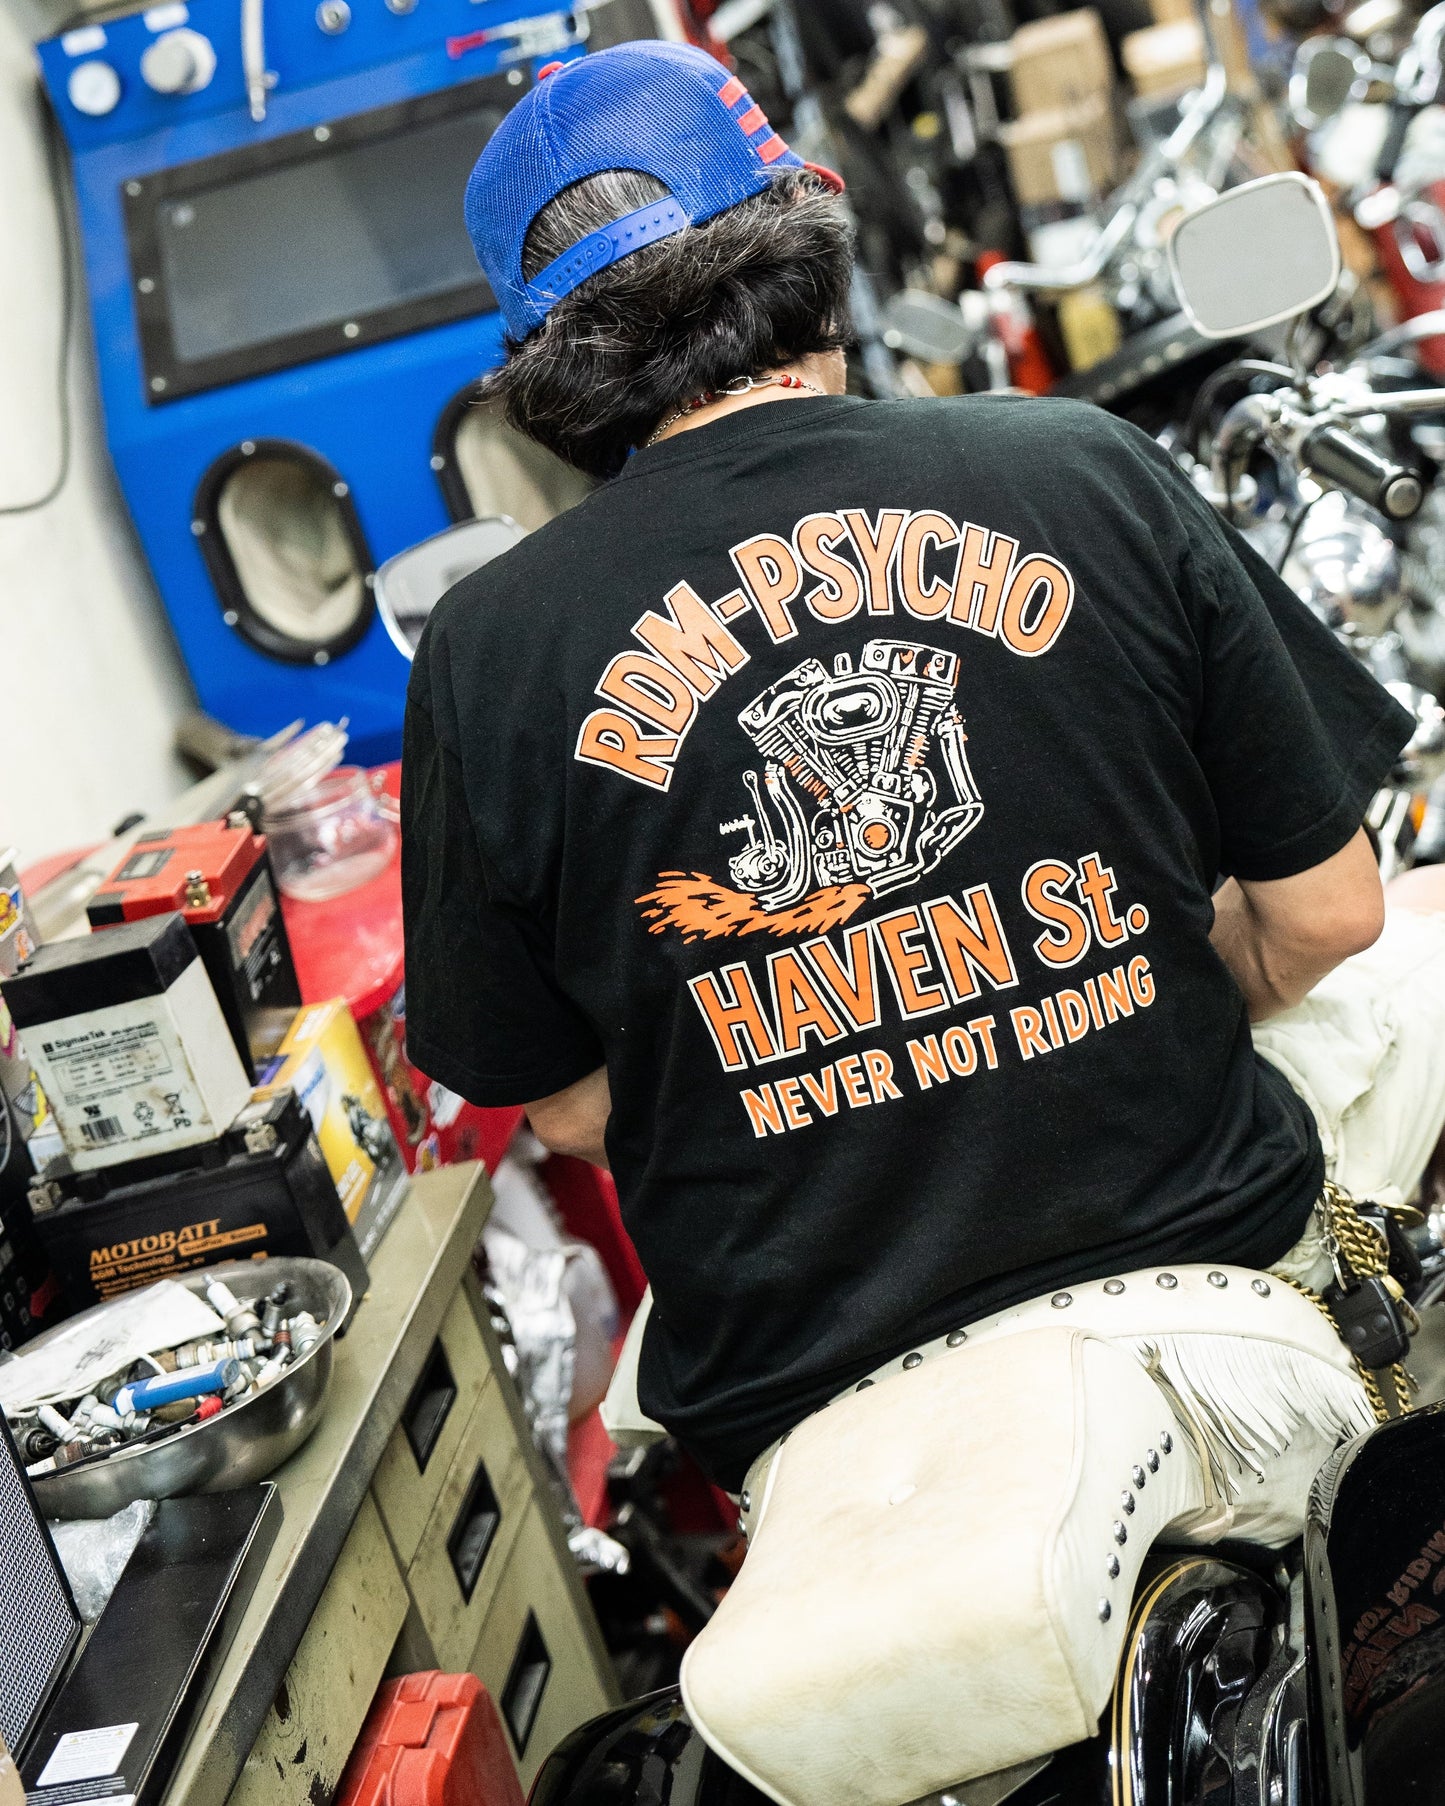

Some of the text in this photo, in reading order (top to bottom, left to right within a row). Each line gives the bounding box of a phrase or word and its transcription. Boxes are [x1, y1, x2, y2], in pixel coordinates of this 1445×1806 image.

[574, 508, 1075, 791] RDM-PSYCHO
[687, 851, 1150, 1073] HAVEN St.
[739, 954, 1156, 1139] NEVER NOT RIDING
[90, 1218, 221, 1266] MOTOBATT
